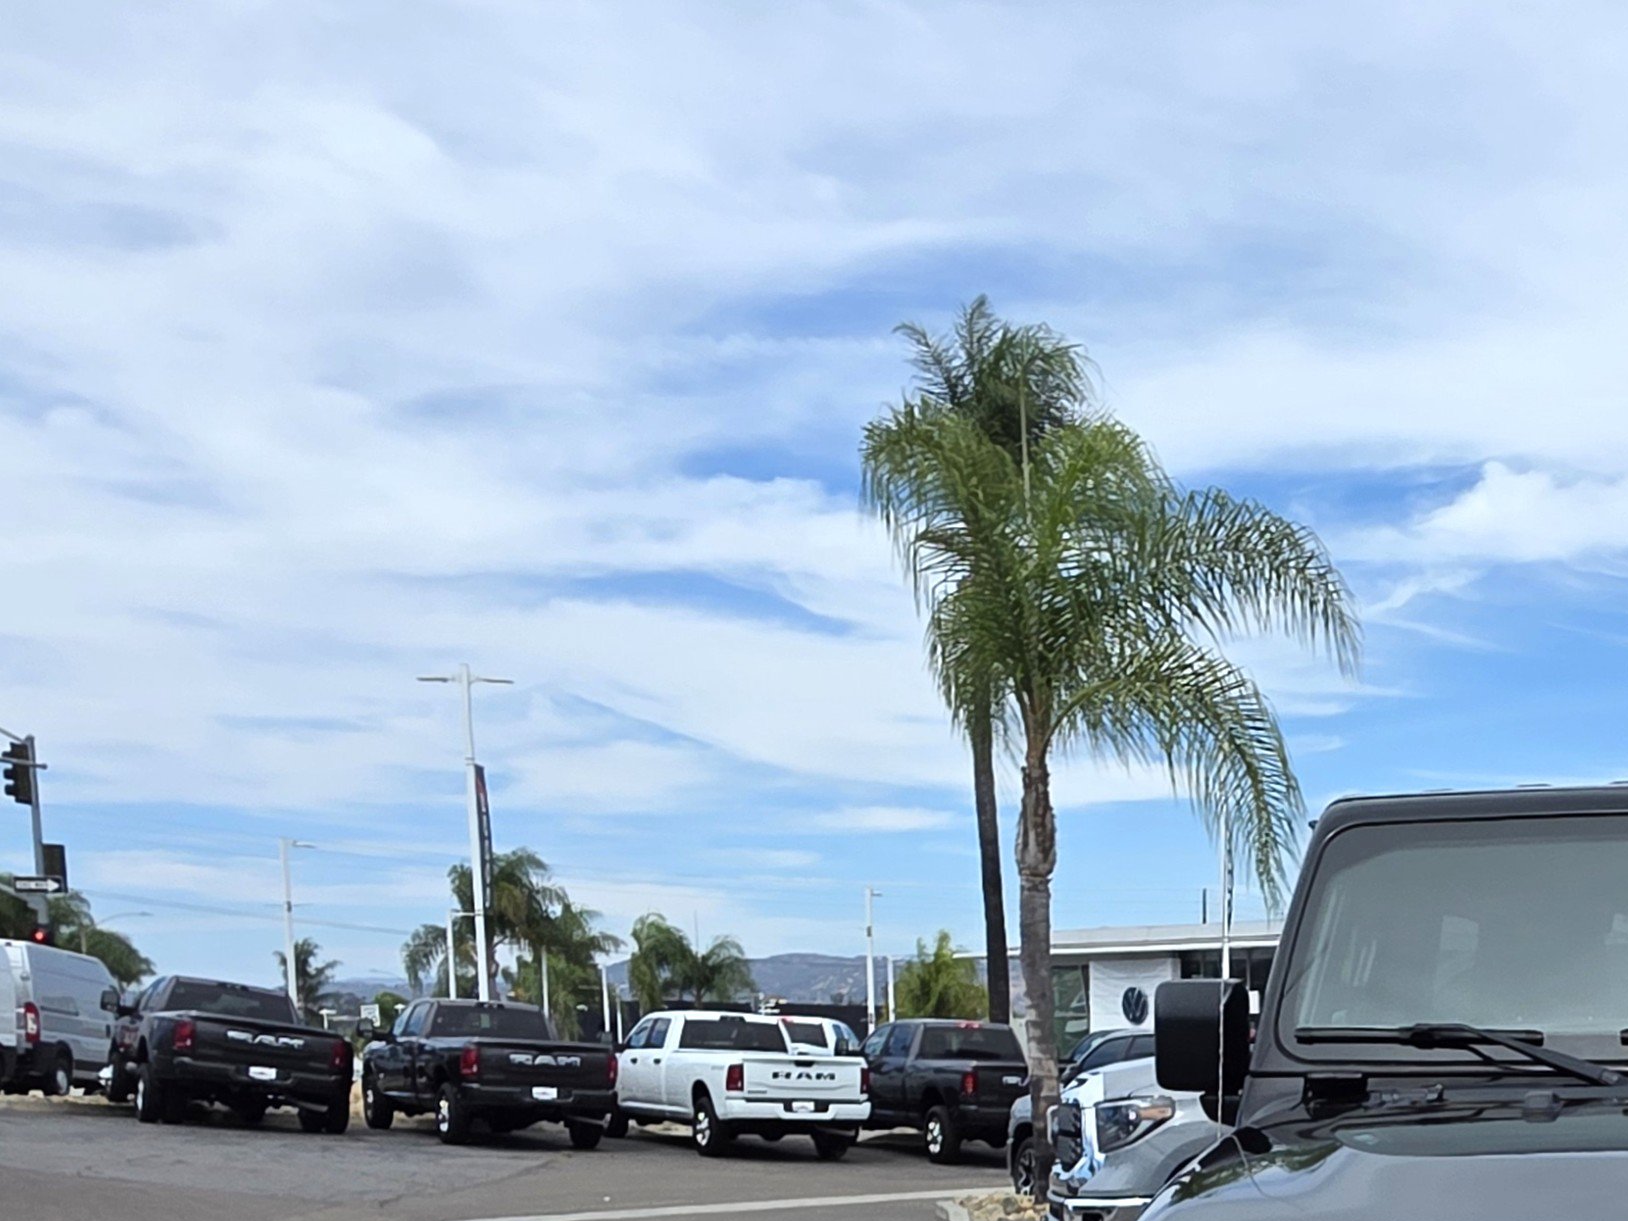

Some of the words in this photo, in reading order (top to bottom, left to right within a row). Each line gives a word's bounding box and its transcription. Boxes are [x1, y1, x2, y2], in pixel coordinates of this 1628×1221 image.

[226, 1030, 304, 1049] RAM
[509, 1053, 581, 1067] RAM
[771, 1071, 836, 1081] RAM
